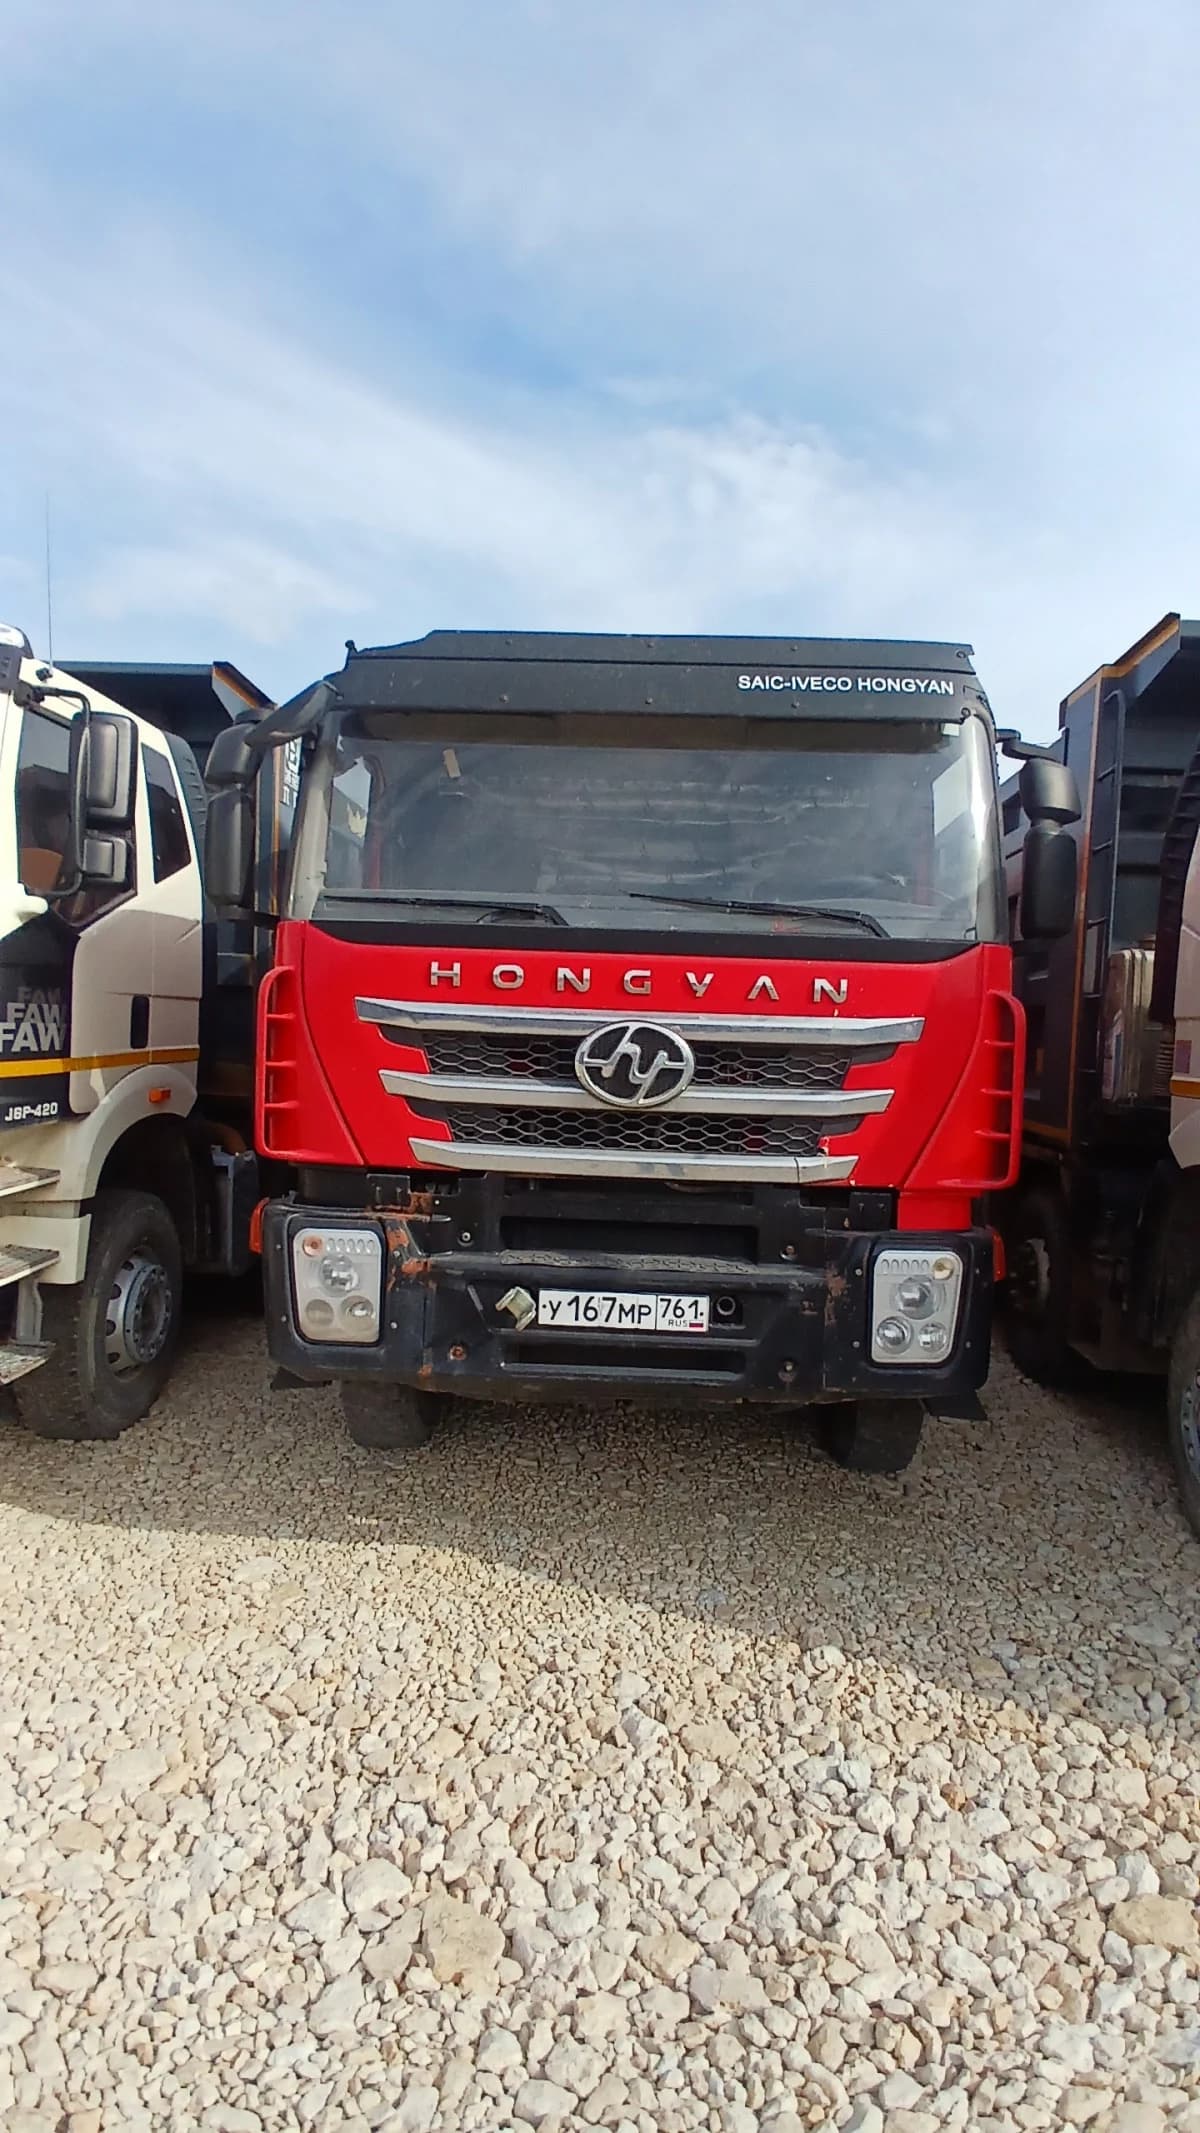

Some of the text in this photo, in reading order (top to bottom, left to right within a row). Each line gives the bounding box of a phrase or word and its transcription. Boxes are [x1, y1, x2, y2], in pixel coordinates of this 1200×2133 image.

[738, 675, 954, 695] SAIC-IVECO HONGYAN
[430, 961, 848, 1003] HONGYAN
[7, 1002, 60, 1025] FAW
[0, 1022, 64, 1052] FAW
[659, 1298, 700, 1319] 761
[668, 1319, 688, 1327] RUS
